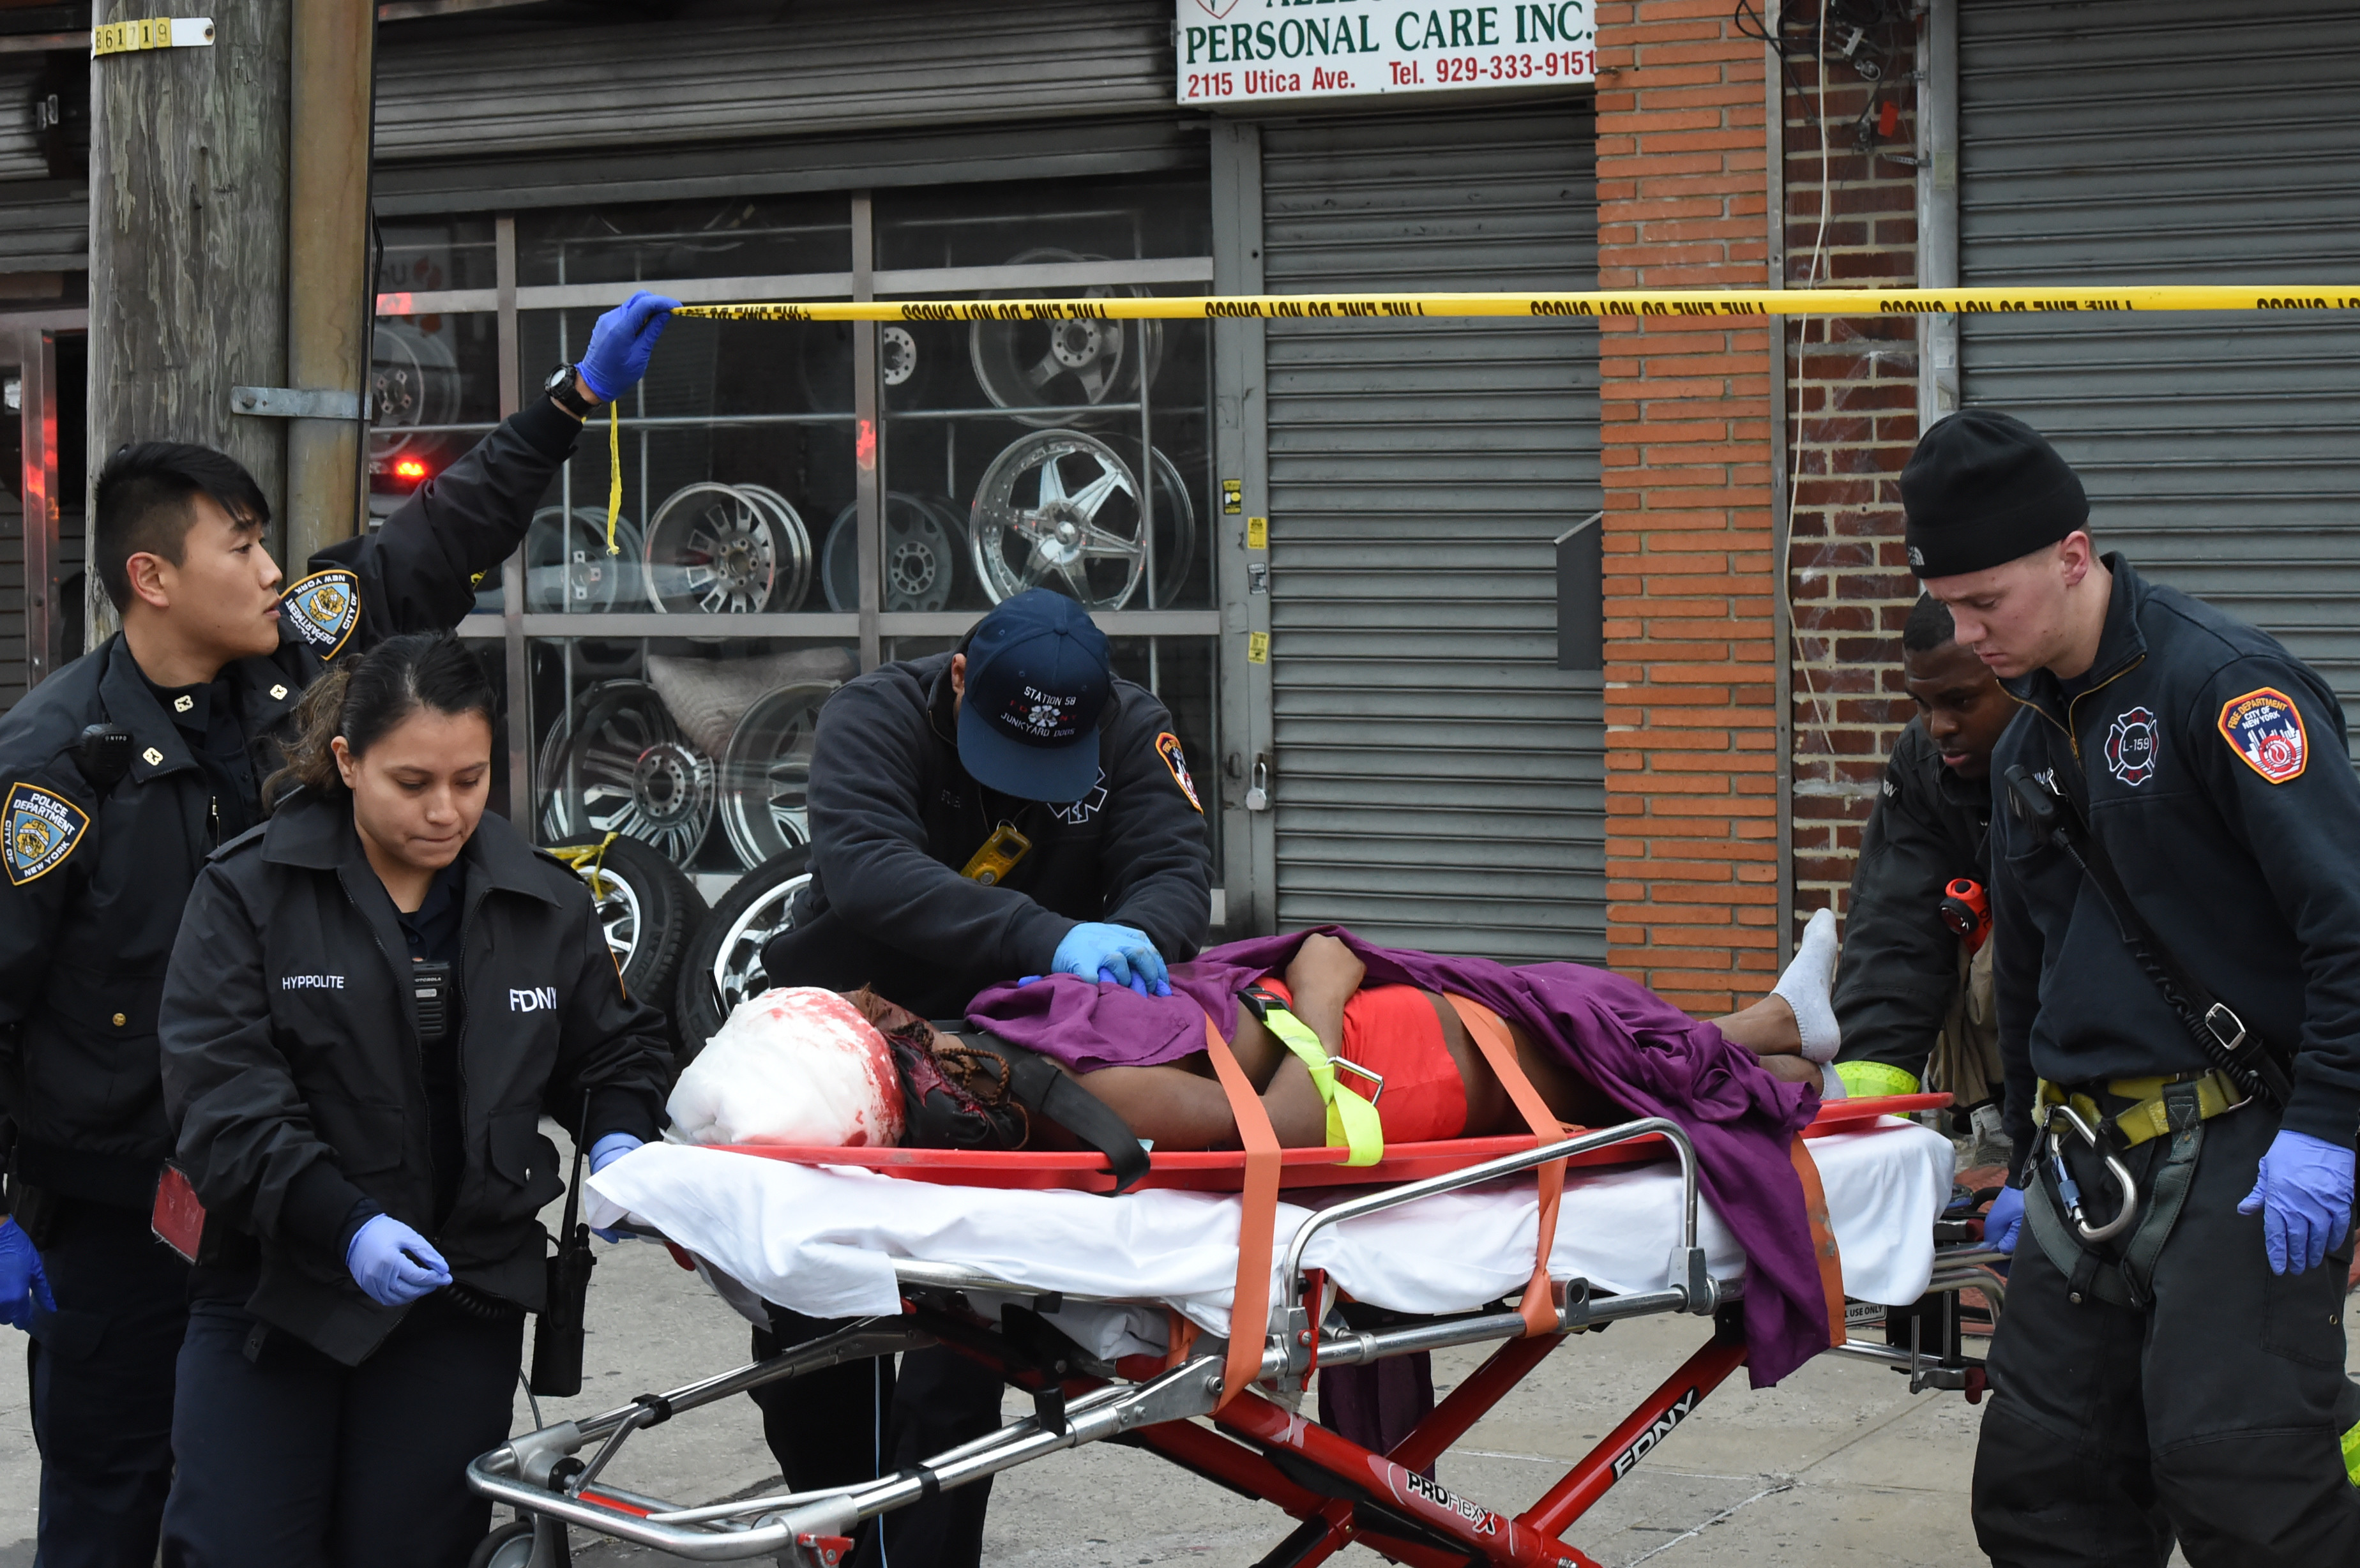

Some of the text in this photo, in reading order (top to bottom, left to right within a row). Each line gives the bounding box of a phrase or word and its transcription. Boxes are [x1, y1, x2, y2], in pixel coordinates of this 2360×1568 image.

[1186, 1, 1592, 64] PERSONAL CARE INC.
[1188, 50, 1594, 97] 2115 Utica Ave. Tel. 929-333-9151
[294, 575, 345, 594] NEW YORK
[285, 598, 337, 645] DEPARTMENT
[342, 592, 358, 630] CITY OF
[1024, 686, 1062, 706] STATION
[1001, 712, 1050, 737] JUNKYARD
[2228, 697, 2288, 729] FIRE DEPARTMENT
[2242, 711, 2280, 730] NEW YORK
[2244, 705, 2271, 721] CITY OF
[2122, 737, 2149, 752] L-159
[13, 799, 75, 836] DEPARTMENT
[30, 793, 68, 818] POLICE
[6, 849, 14, 863] OF
[24, 841, 70, 877] NEW YORK
[282, 976, 345, 990] HYPPOLITE
[1850, 1307, 1863, 1317] USE
[1865, 1304, 1882, 1315] ONLY
[1614, 1387, 1696, 1480] FDNY
